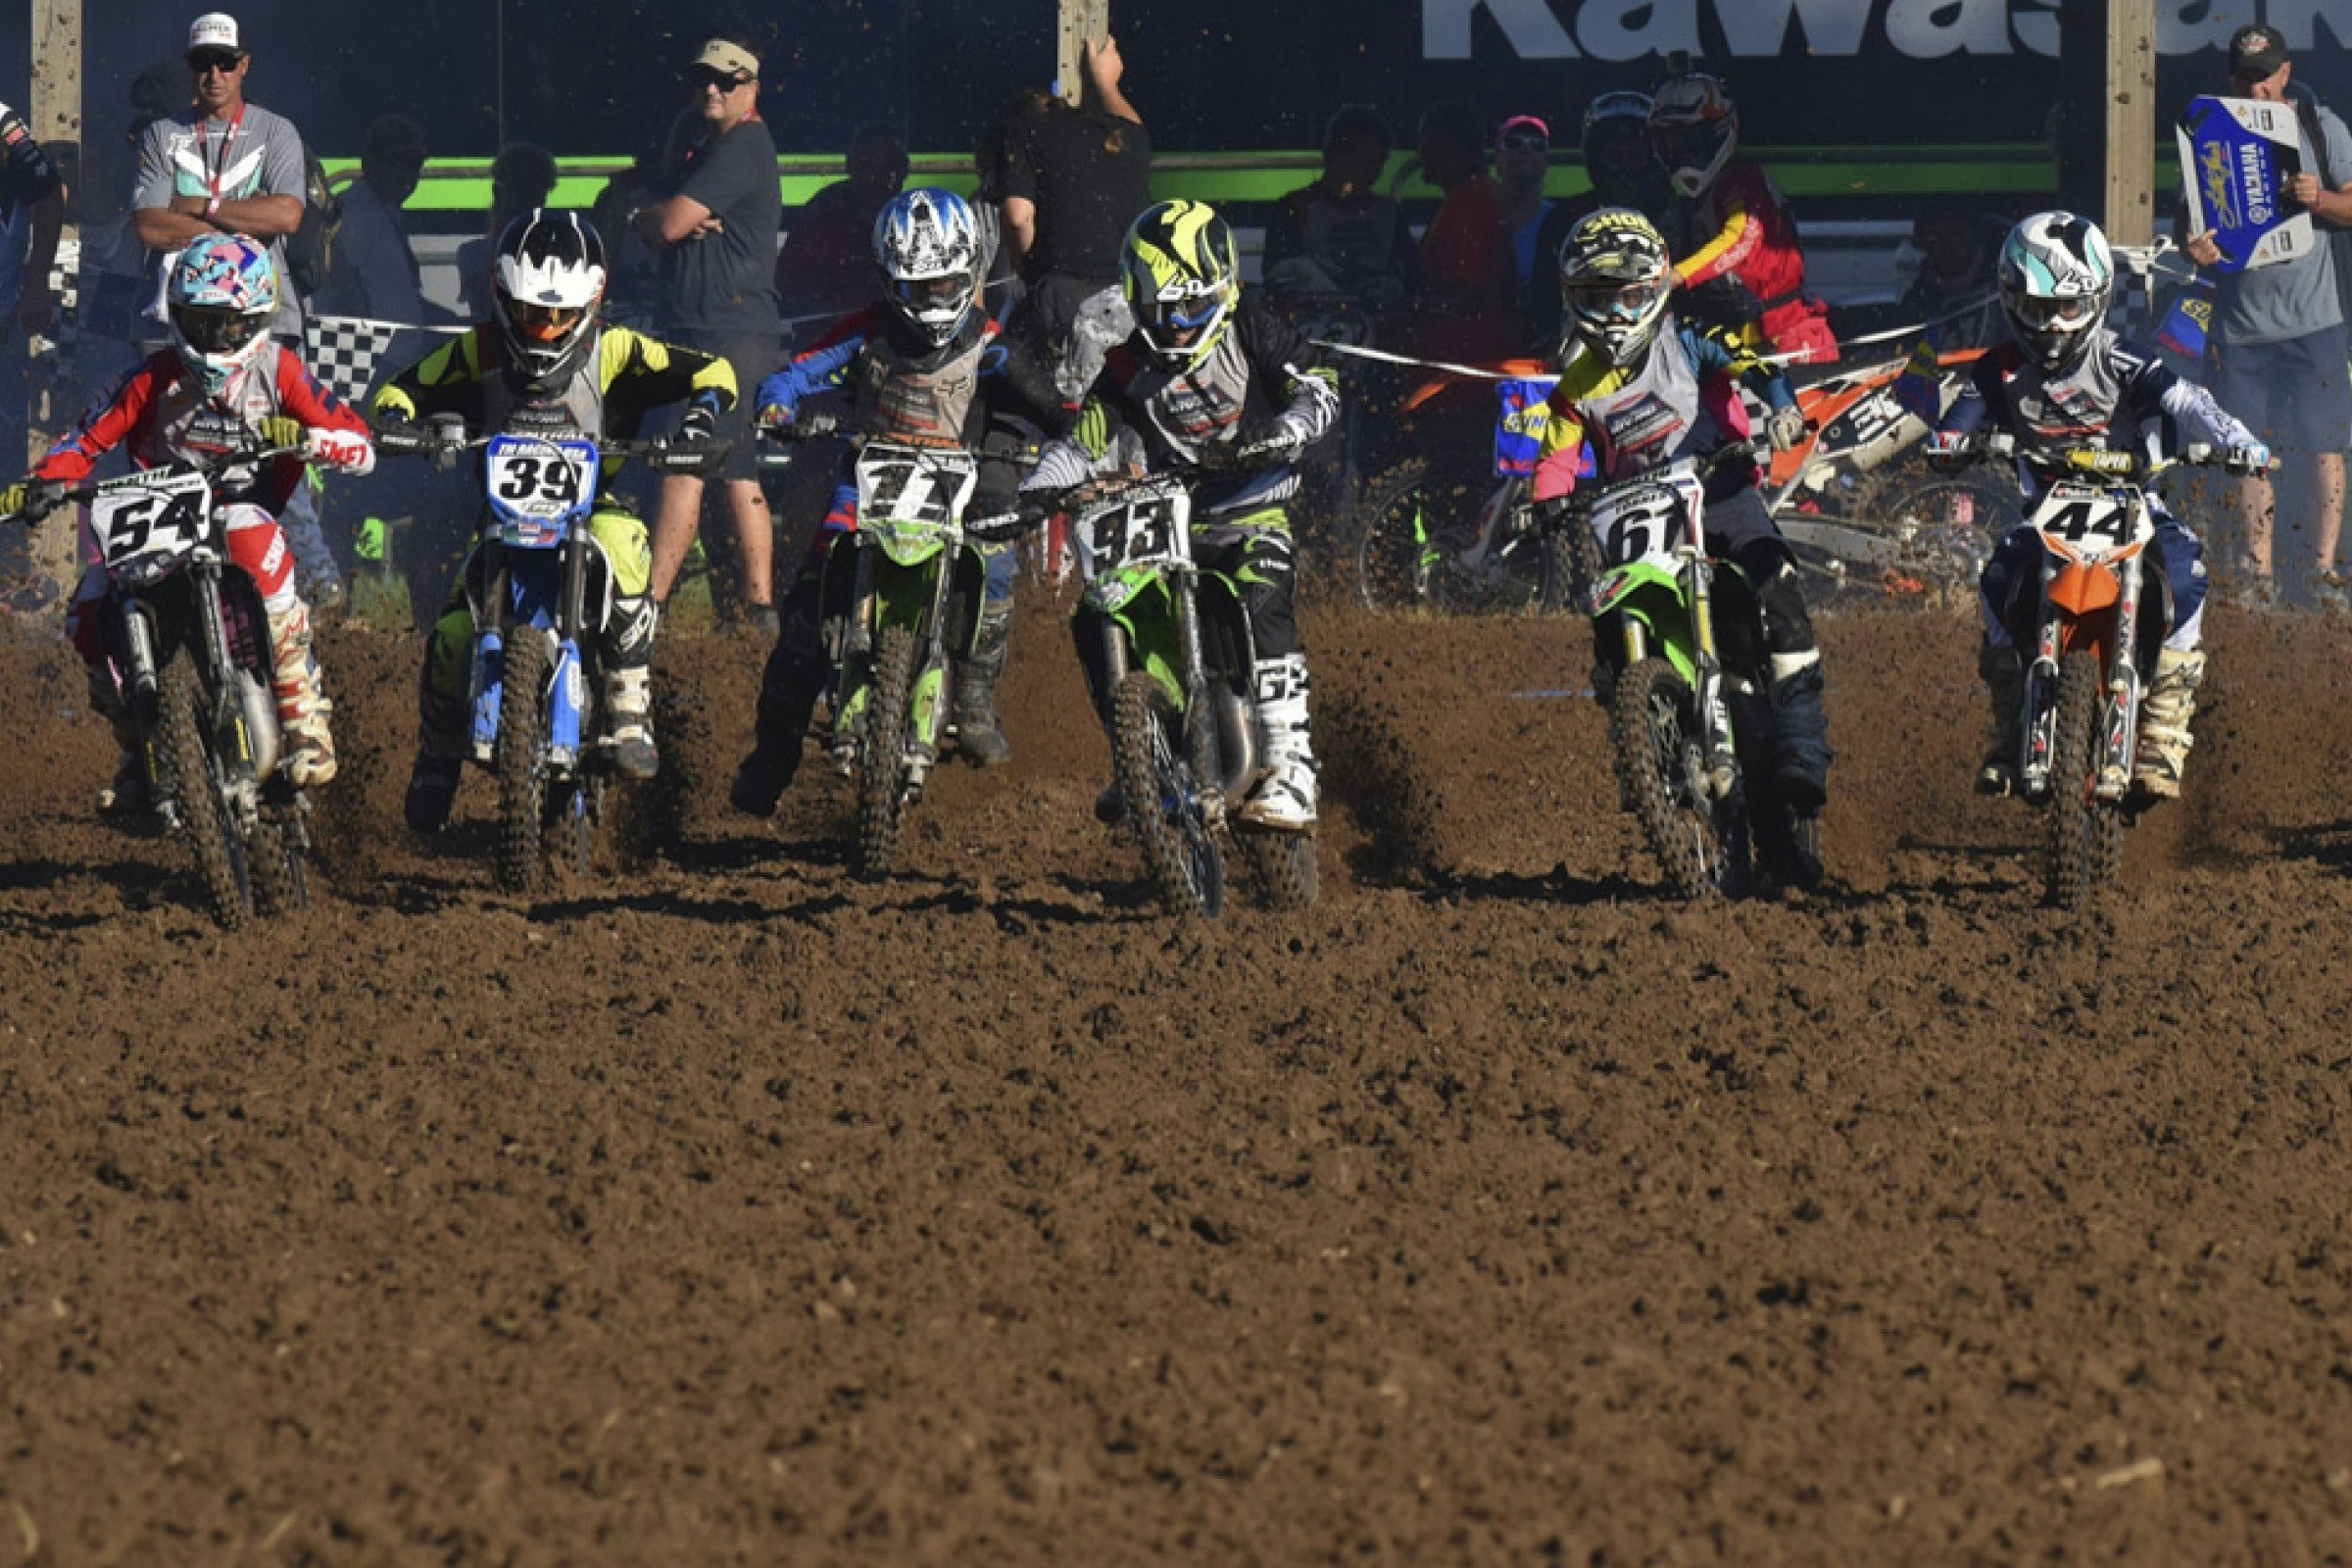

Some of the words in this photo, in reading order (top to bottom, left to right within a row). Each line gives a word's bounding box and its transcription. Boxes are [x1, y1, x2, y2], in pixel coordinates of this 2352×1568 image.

[498, 458, 582, 502] 39
[109, 490, 206, 565] 54
[1092, 497, 1174, 576] 93
[2043, 502, 2137, 546] 44
